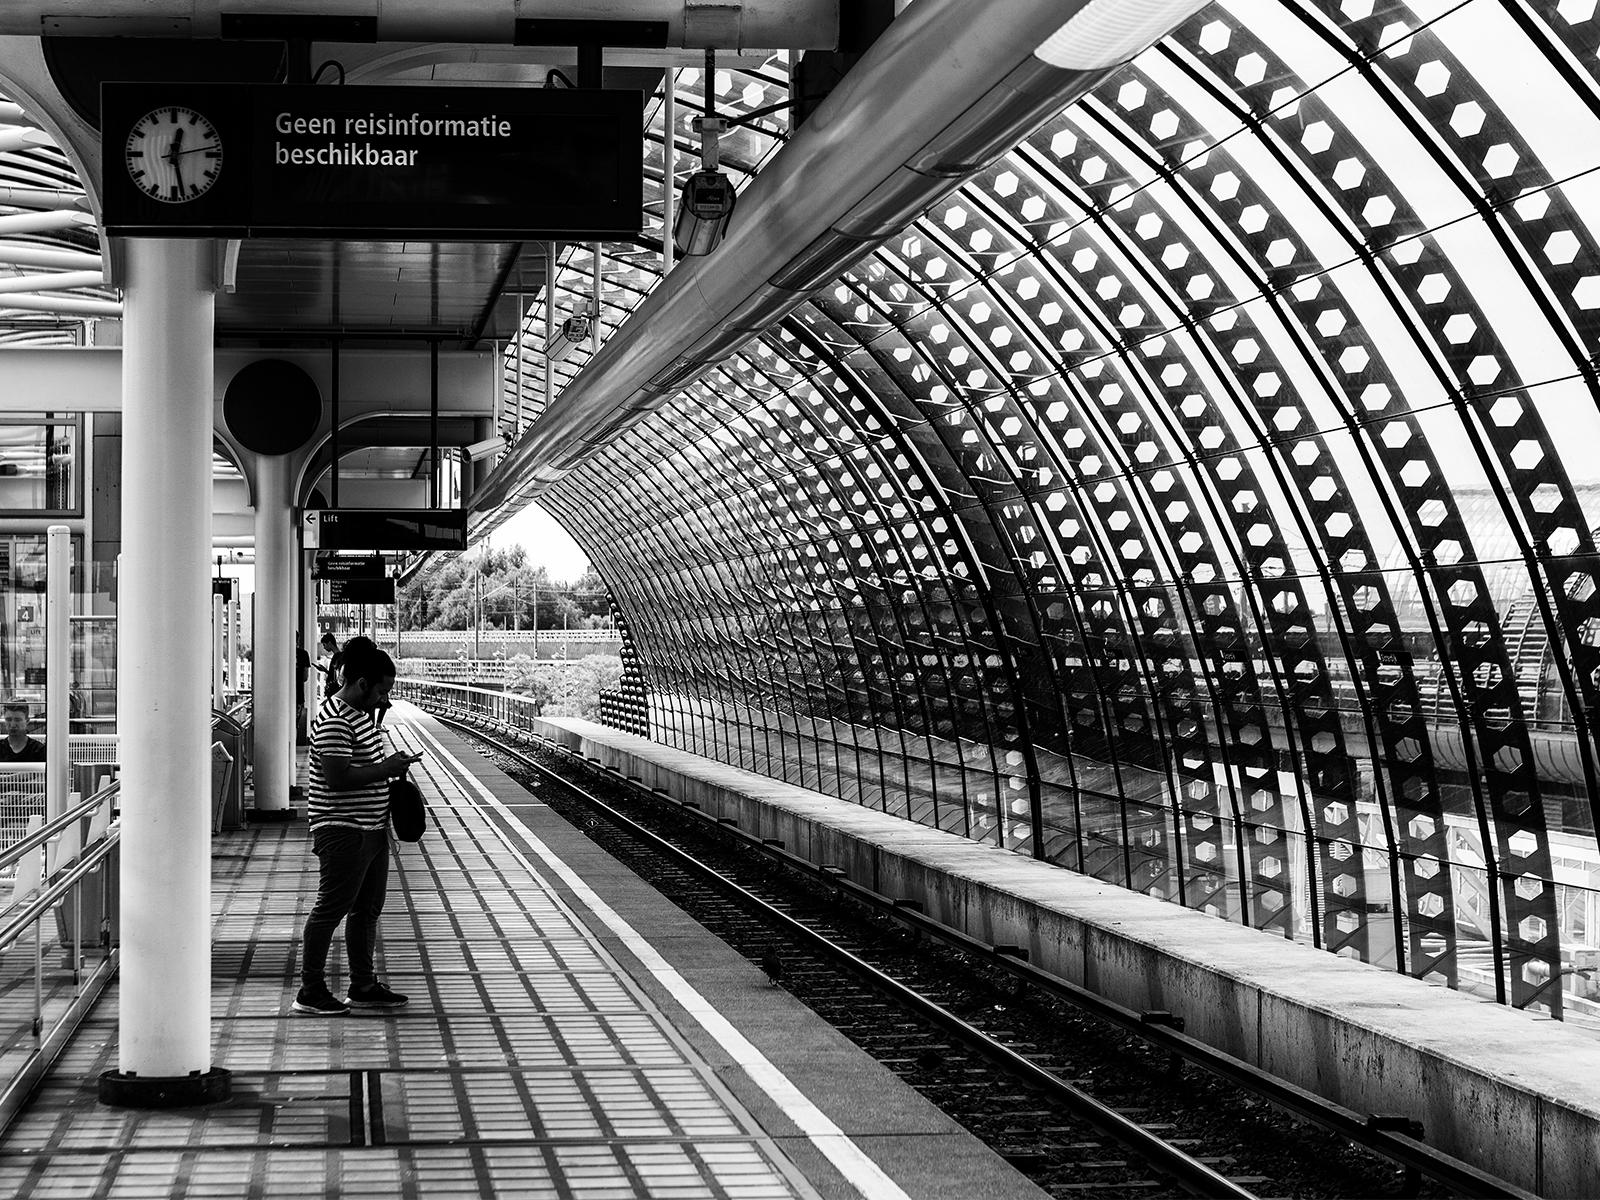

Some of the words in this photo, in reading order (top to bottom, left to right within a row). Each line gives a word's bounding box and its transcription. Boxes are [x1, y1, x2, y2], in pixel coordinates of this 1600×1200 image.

[276, 112, 336, 135] Geen
[345, 113, 512, 137] reisinformatie
[275, 141, 419, 166] beschikbaar
[323, 514, 338, 523] Lift
[21, 610, 31, 621] 4
